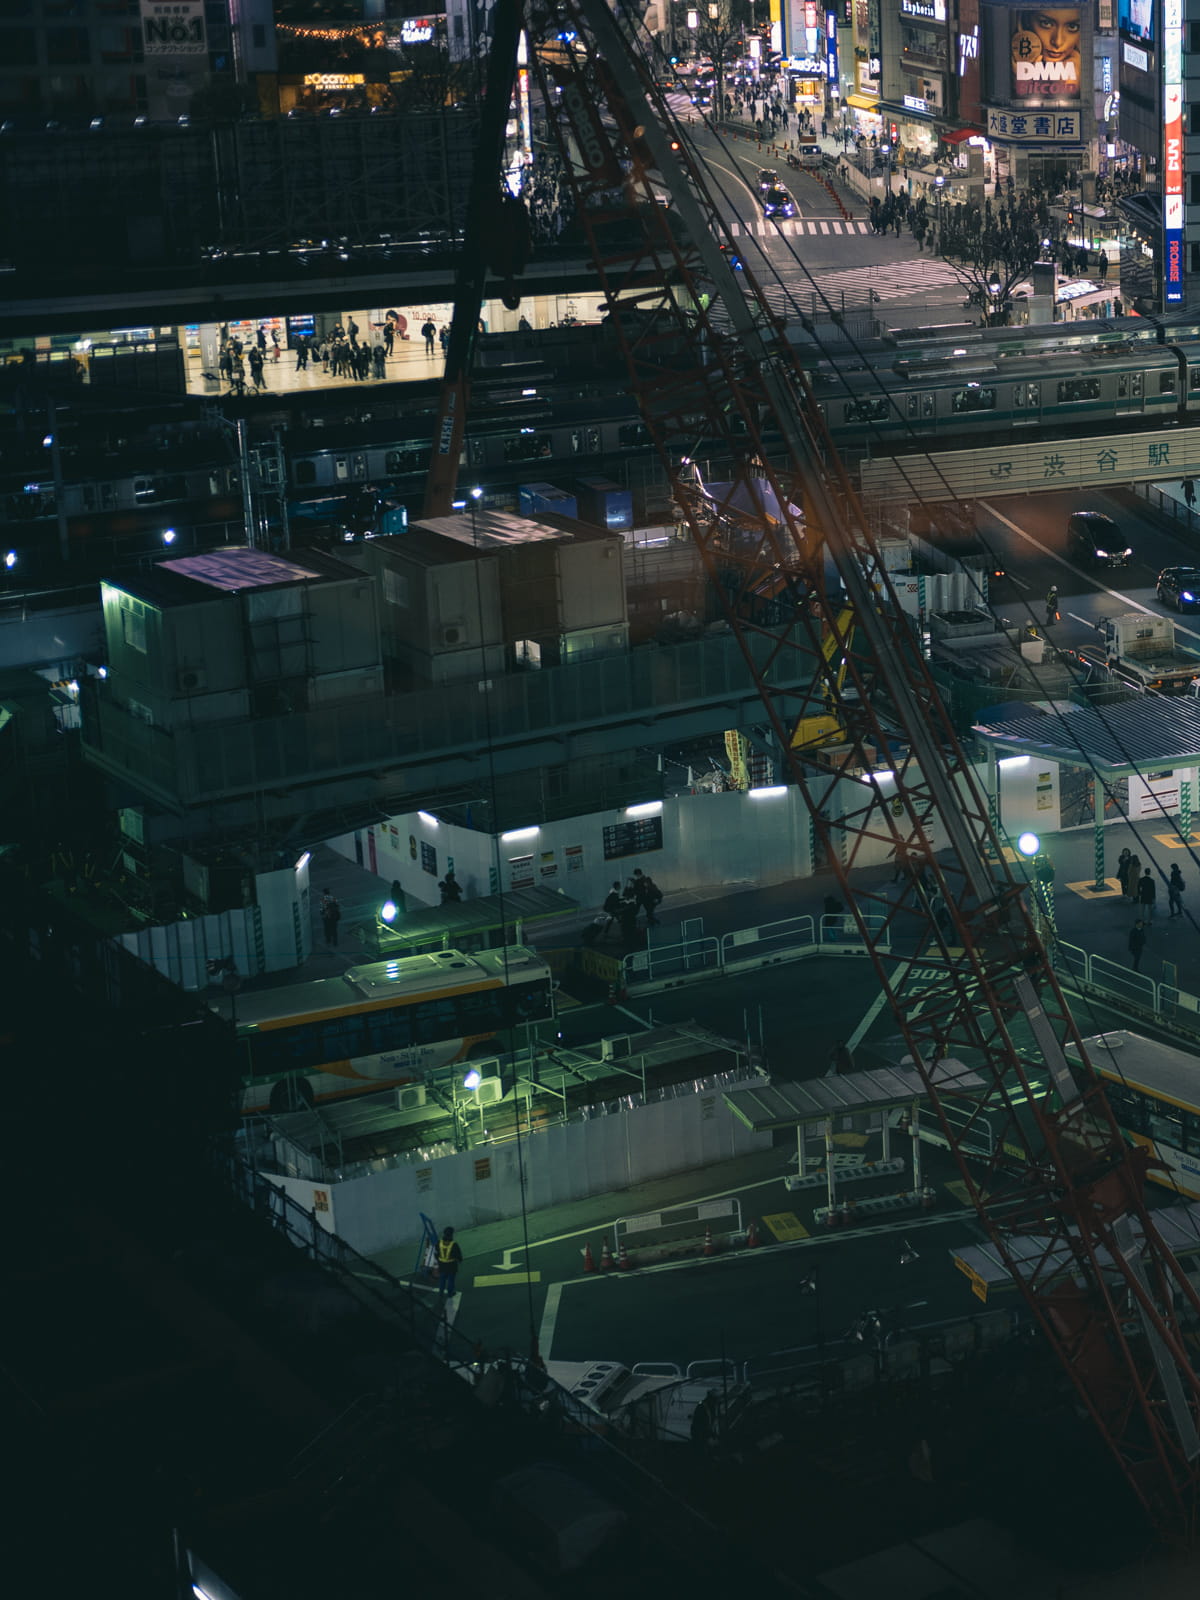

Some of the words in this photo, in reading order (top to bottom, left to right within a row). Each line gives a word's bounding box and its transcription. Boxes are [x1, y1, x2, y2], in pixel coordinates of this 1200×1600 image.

[1016, 61, 1077, 81] DMM
[989, 113, 1075, 136] 大盛堂書店
[1169, 240, 1180, 283] PROMISE
[1043, 443, 1171, 477] 渋谷駅
